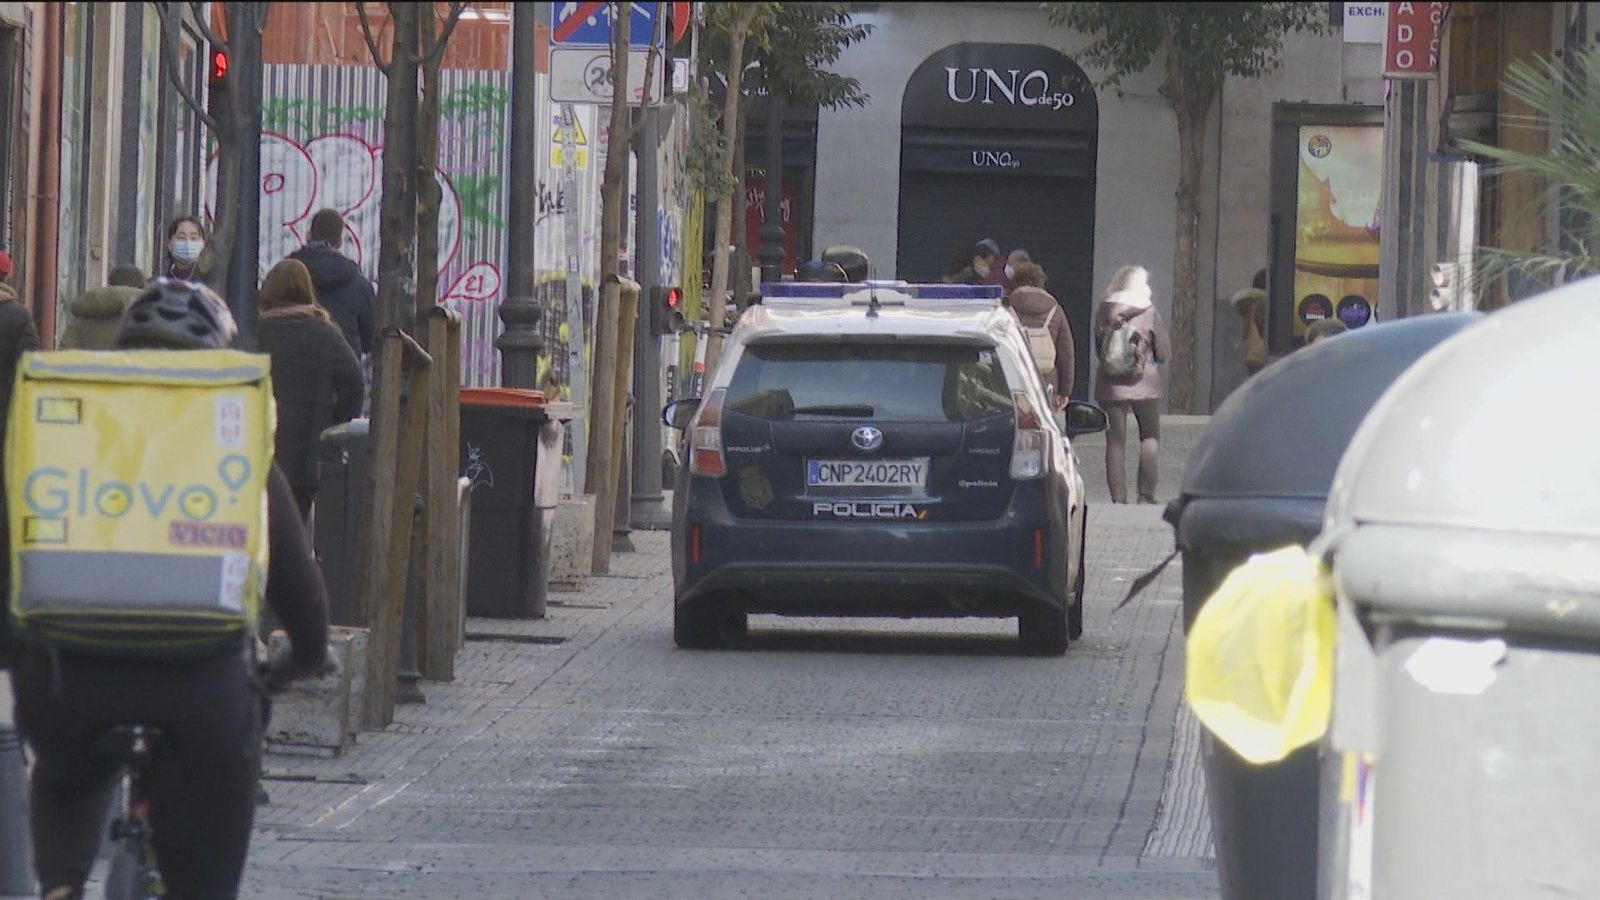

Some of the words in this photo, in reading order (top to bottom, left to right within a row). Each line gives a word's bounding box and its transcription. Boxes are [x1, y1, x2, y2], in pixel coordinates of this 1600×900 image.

[1348, 7, 1385, 16] EXCH
[819, 464, 922, 483] CNP2402RY
[812, 503, 918, 517] POLICIA
